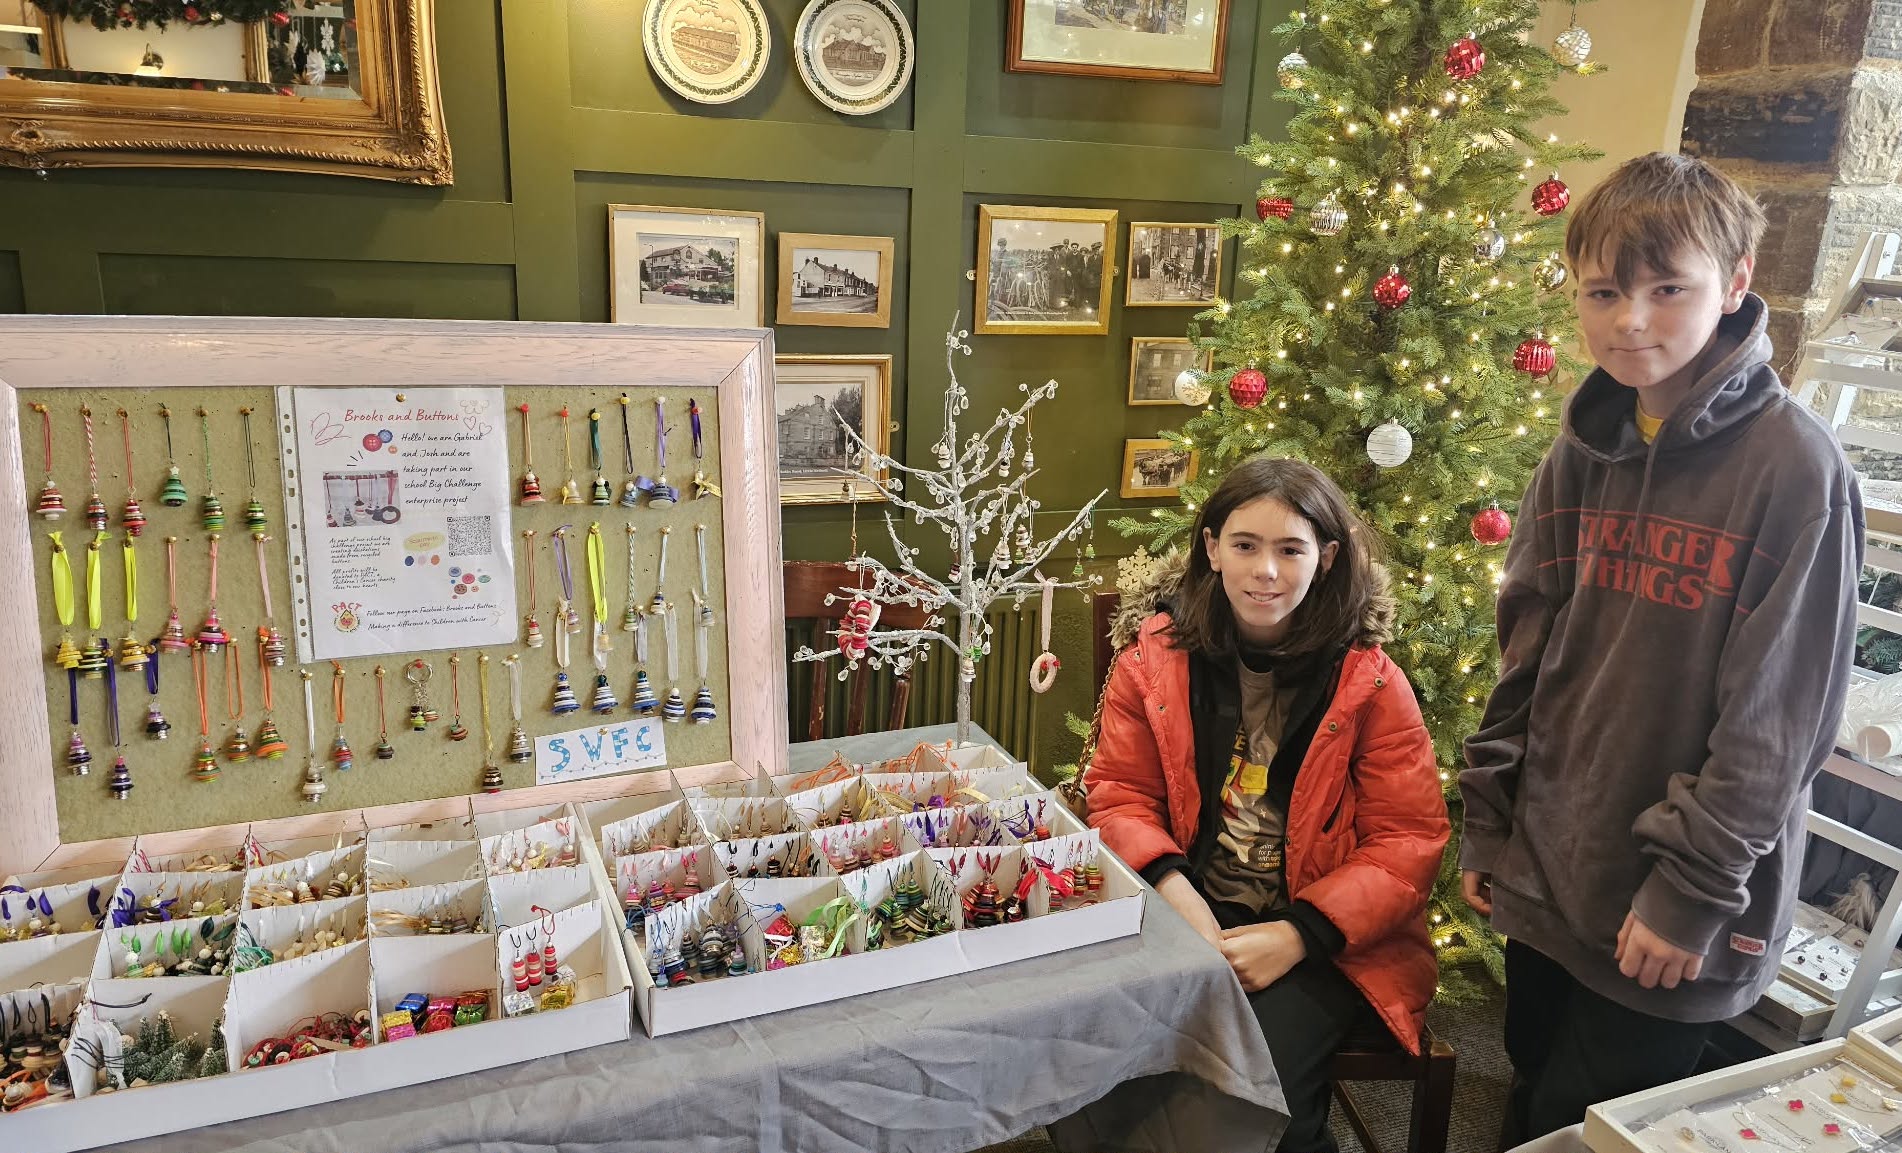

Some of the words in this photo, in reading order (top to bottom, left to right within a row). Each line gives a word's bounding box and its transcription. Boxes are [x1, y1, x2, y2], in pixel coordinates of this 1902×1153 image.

[344, 409, 383, 421] Brooks
[388, 410, 412, 421] and
[416, 408, 459, 421] Buttons
[401, 432, 425, 441] Hello!
[453, 432, 483, 442] Gabriel
[402, 449, 418, 457] and
[420, 448, 439, 457] Josh
[440, 448, 457, 457] and
[403, 465, 428, 476] taking
[429, 465, 448, 476] part
[404, 480, 428, 488] school
[429, 480, 442, 492] Big
[444, 478, 482, 491] Challenge
[405, 496, 442, 508] enterprise
[442, 496, 469, 507] project
[1580, 553, 1704, 610] THINGS
[331, 601, 362, 613] PACT
[367, 623, 391, 631] Making
[549, 725, 652, 773] SWFC
